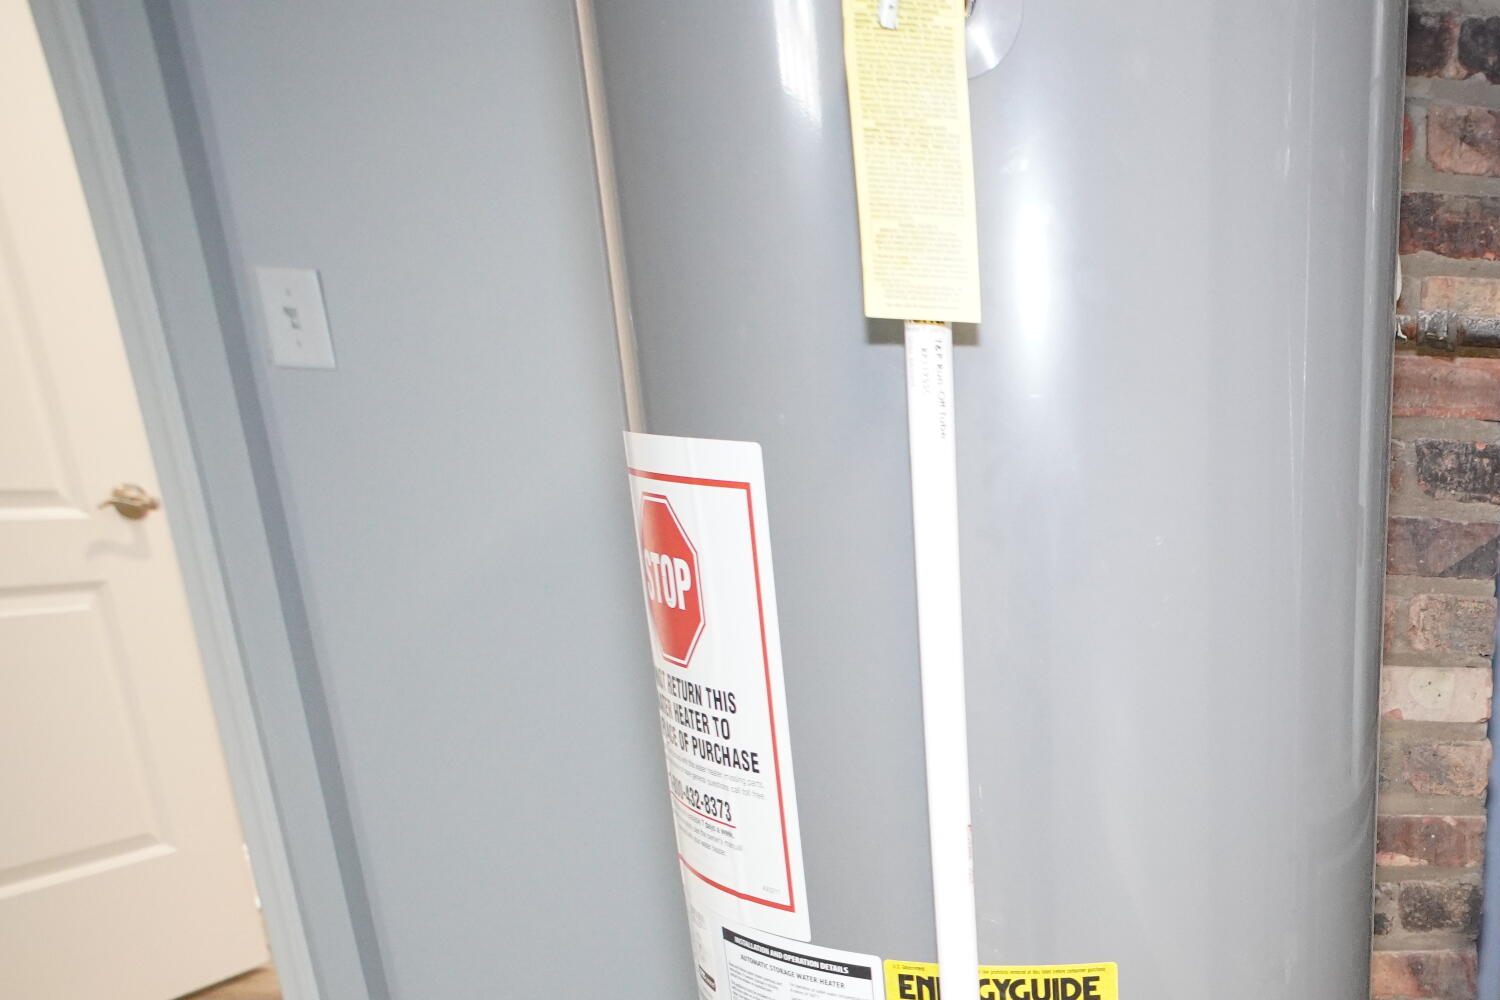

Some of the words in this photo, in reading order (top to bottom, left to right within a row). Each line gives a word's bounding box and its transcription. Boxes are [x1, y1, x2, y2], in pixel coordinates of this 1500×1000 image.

[643, 547, 692, 611] STOP
[666, 673, 702, 707] RETURN
[705, 686, 737, 714] THIS
[673, 702, 710, 735] HEATER
[712, 715, 731, 741] TO
[678, 730, 689, 753] OF
[691, 735, 760, 774] PURCHASE
[734, 936, 769, 955] INSTALLATION
[770, 949, 783, 960] AND
[783, 953, 819, 969] OPERATION
[820, 962, 849, 974] DETAILS
[740, 954, 769, 970] AUTOMATIC
[769, 964, 795, 978] STORAGE
[796, 972, 818, 983] WATER
[819, 979, 845, 989] HEATER
